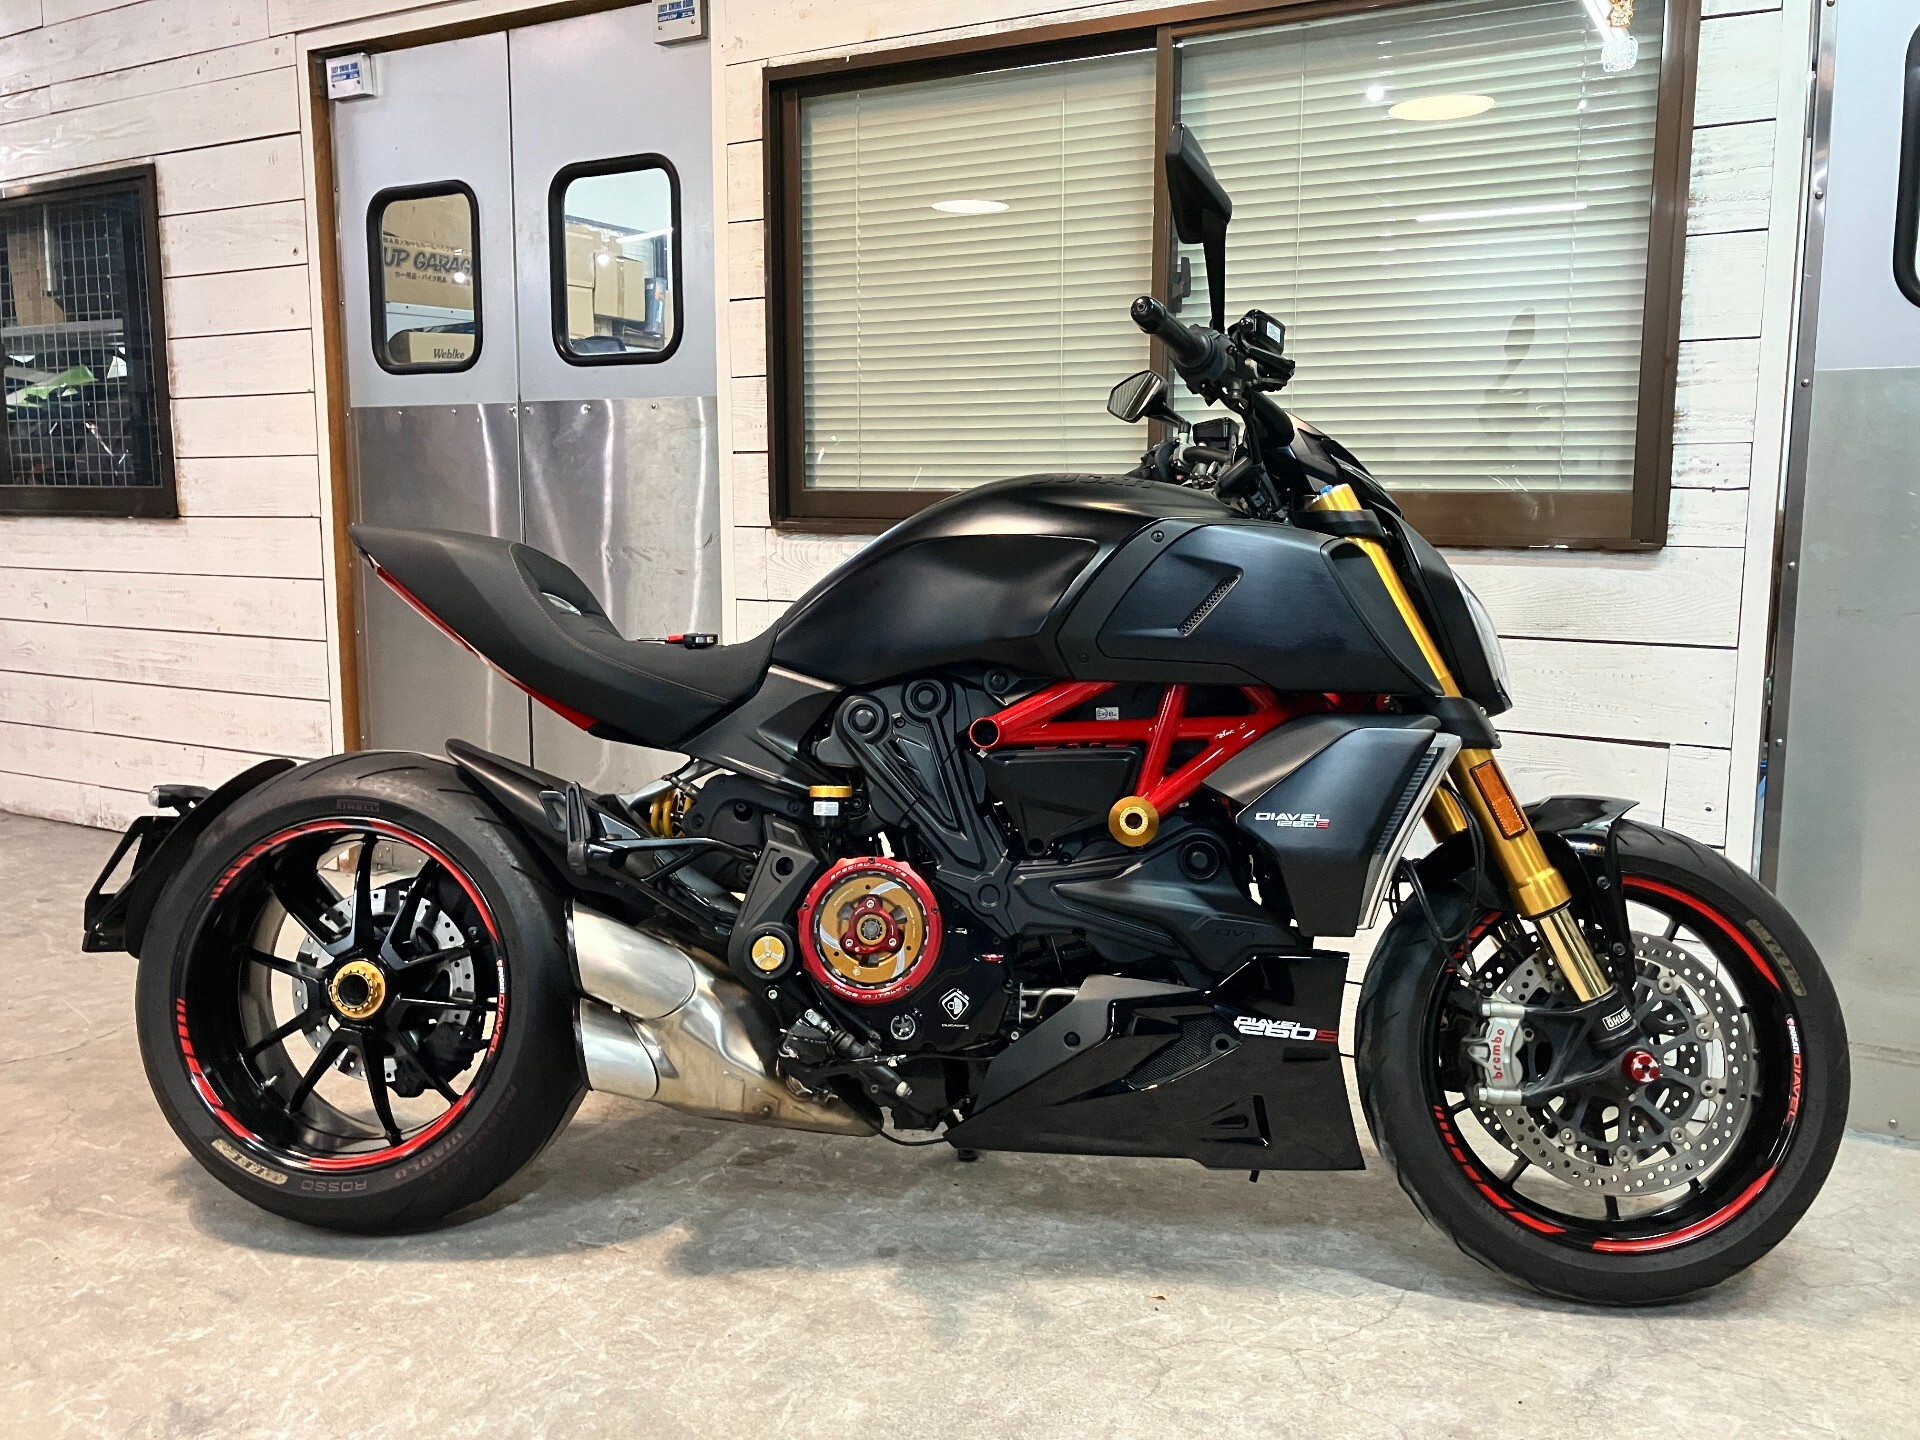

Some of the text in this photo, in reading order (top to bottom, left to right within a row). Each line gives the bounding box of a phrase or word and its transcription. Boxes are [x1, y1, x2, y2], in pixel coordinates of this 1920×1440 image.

[1255, 812, 1330, 822] DIAVEL
[1491, 1028, 1505, 1080] brembo
[1785, 1053, 1802, 1122] DIAVEL
[301, 1179, 368, 1193] ROSSO
